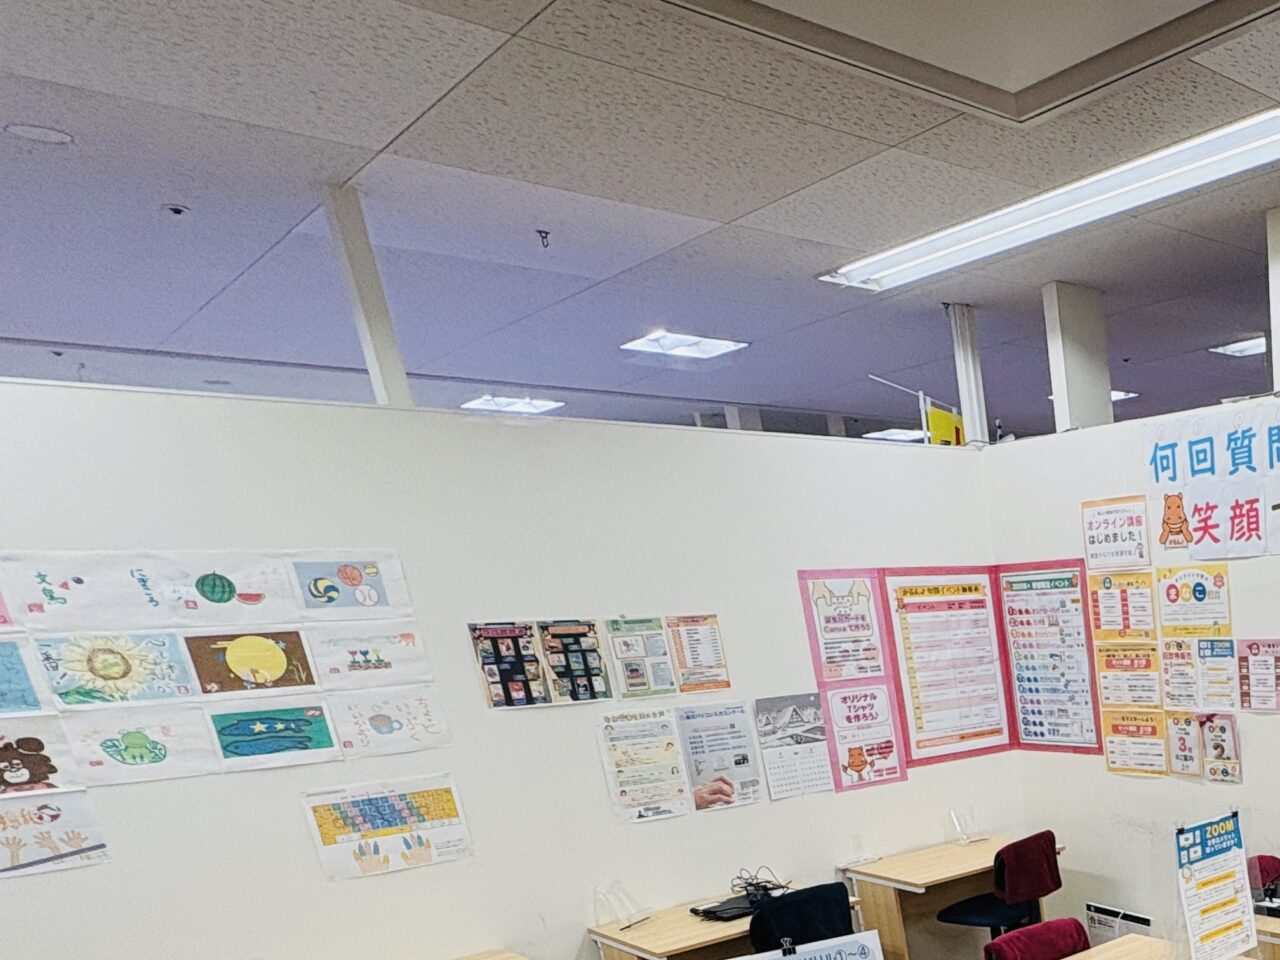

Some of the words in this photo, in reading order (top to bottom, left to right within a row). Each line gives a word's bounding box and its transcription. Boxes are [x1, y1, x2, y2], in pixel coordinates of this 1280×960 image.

[1087, 515, 1143, 531] オンライン講座
[1088, 531, 1143, 545] はじめました!
[840, 692, 878, 704] オリジナル
[846, 703, 875, 713] Tシャツ
[1205, 820, 1235, 838] ZOOM
